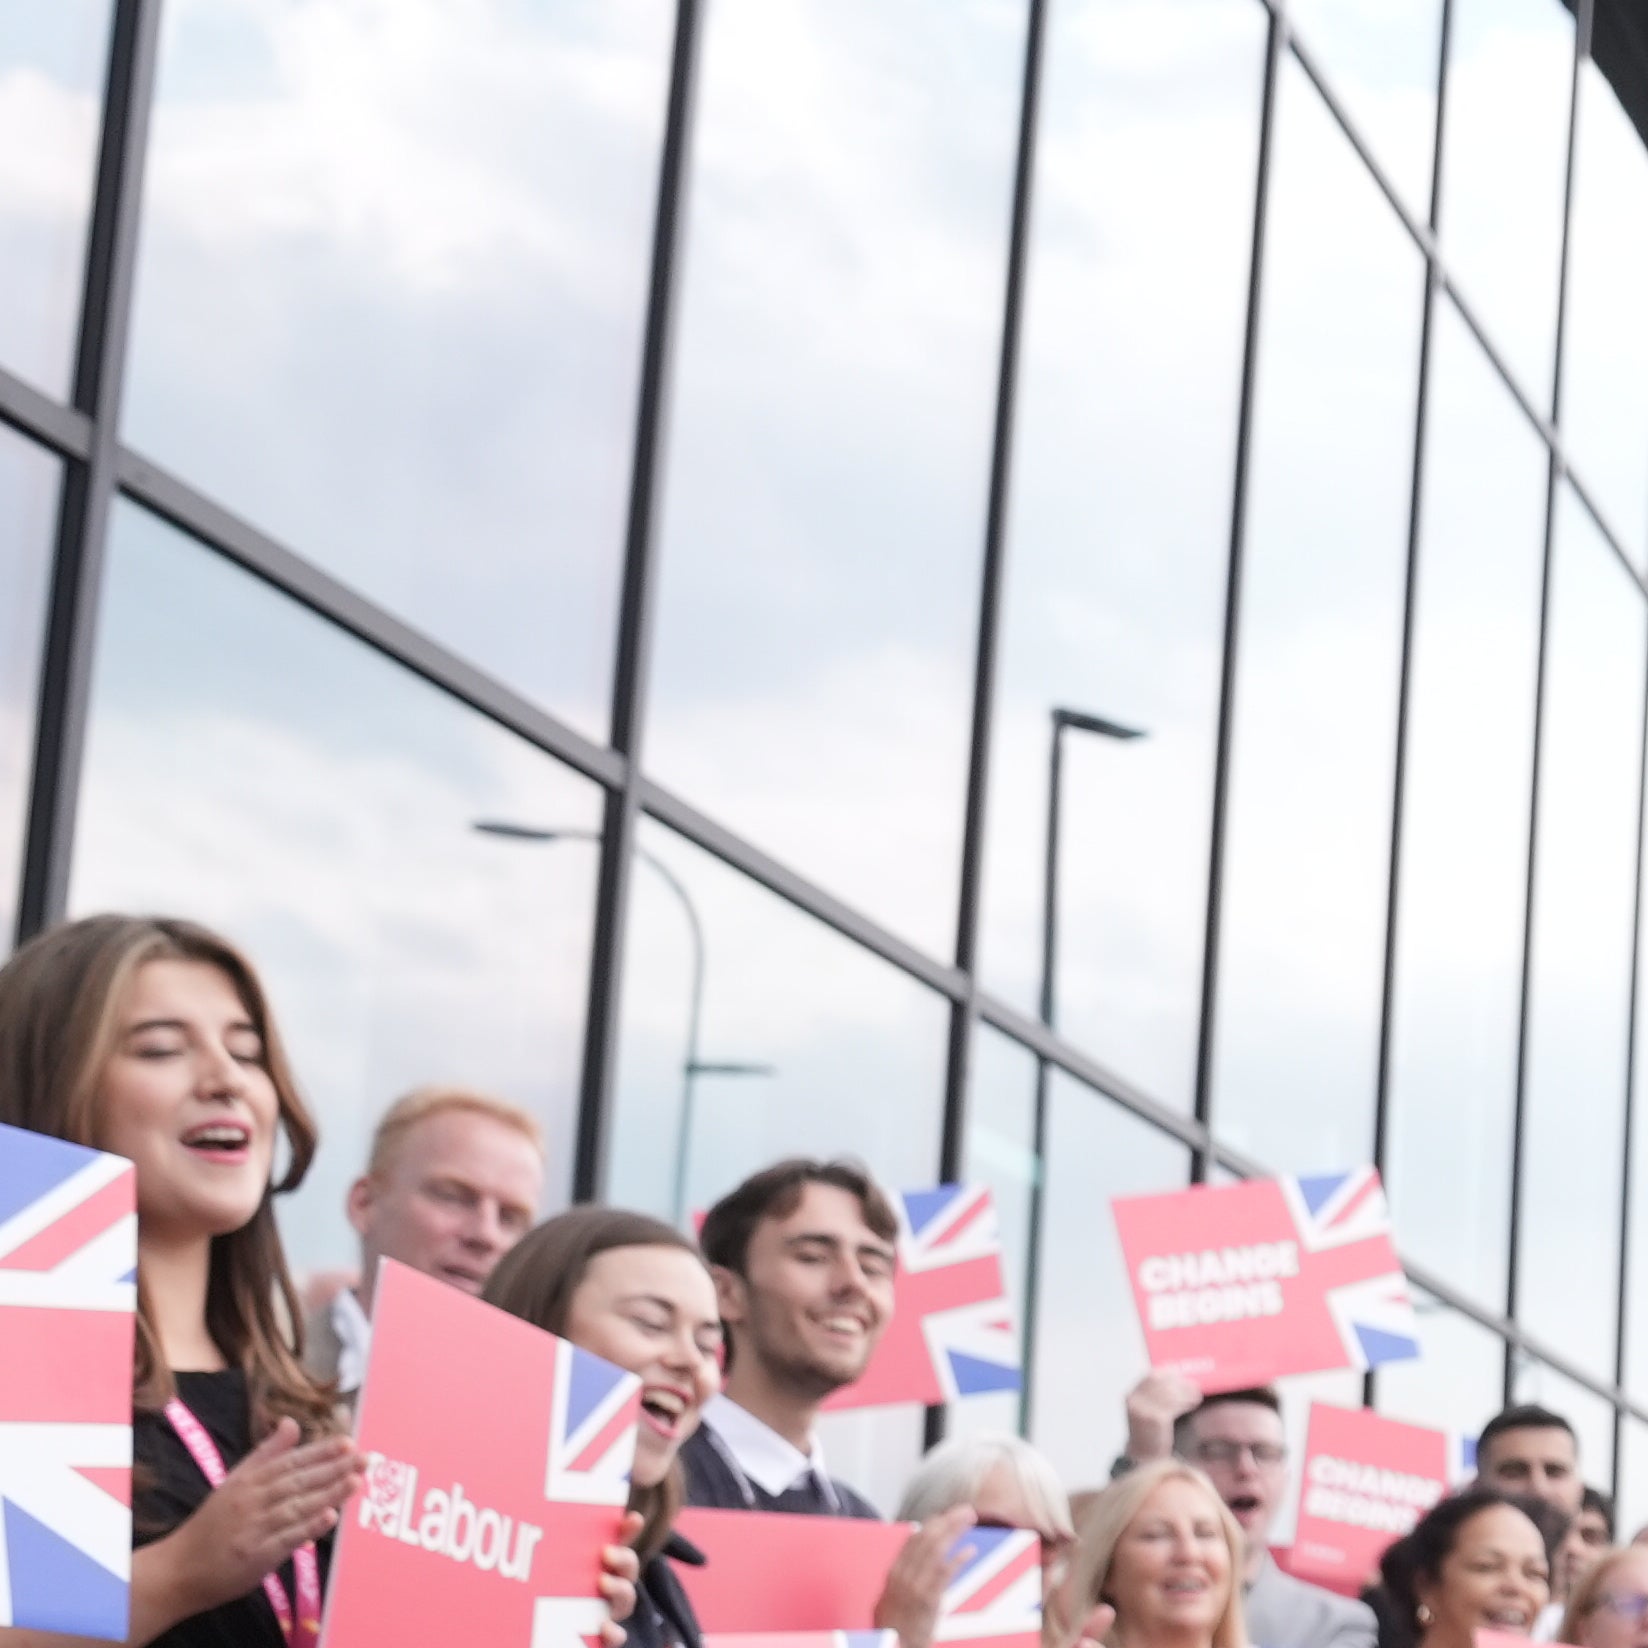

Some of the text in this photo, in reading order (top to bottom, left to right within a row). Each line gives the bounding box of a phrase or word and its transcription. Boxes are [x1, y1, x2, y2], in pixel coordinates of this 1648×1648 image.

[1137, 1239, 1300, 1293] CHANGE
[1147, 1279, 1285, 1331] BEGINS
[1309, 1454, 1444, 1511] CHANGE
[398, 1464, 544, 1583] Labour
[1306, 1486, 1421, 1536] BEGINS
